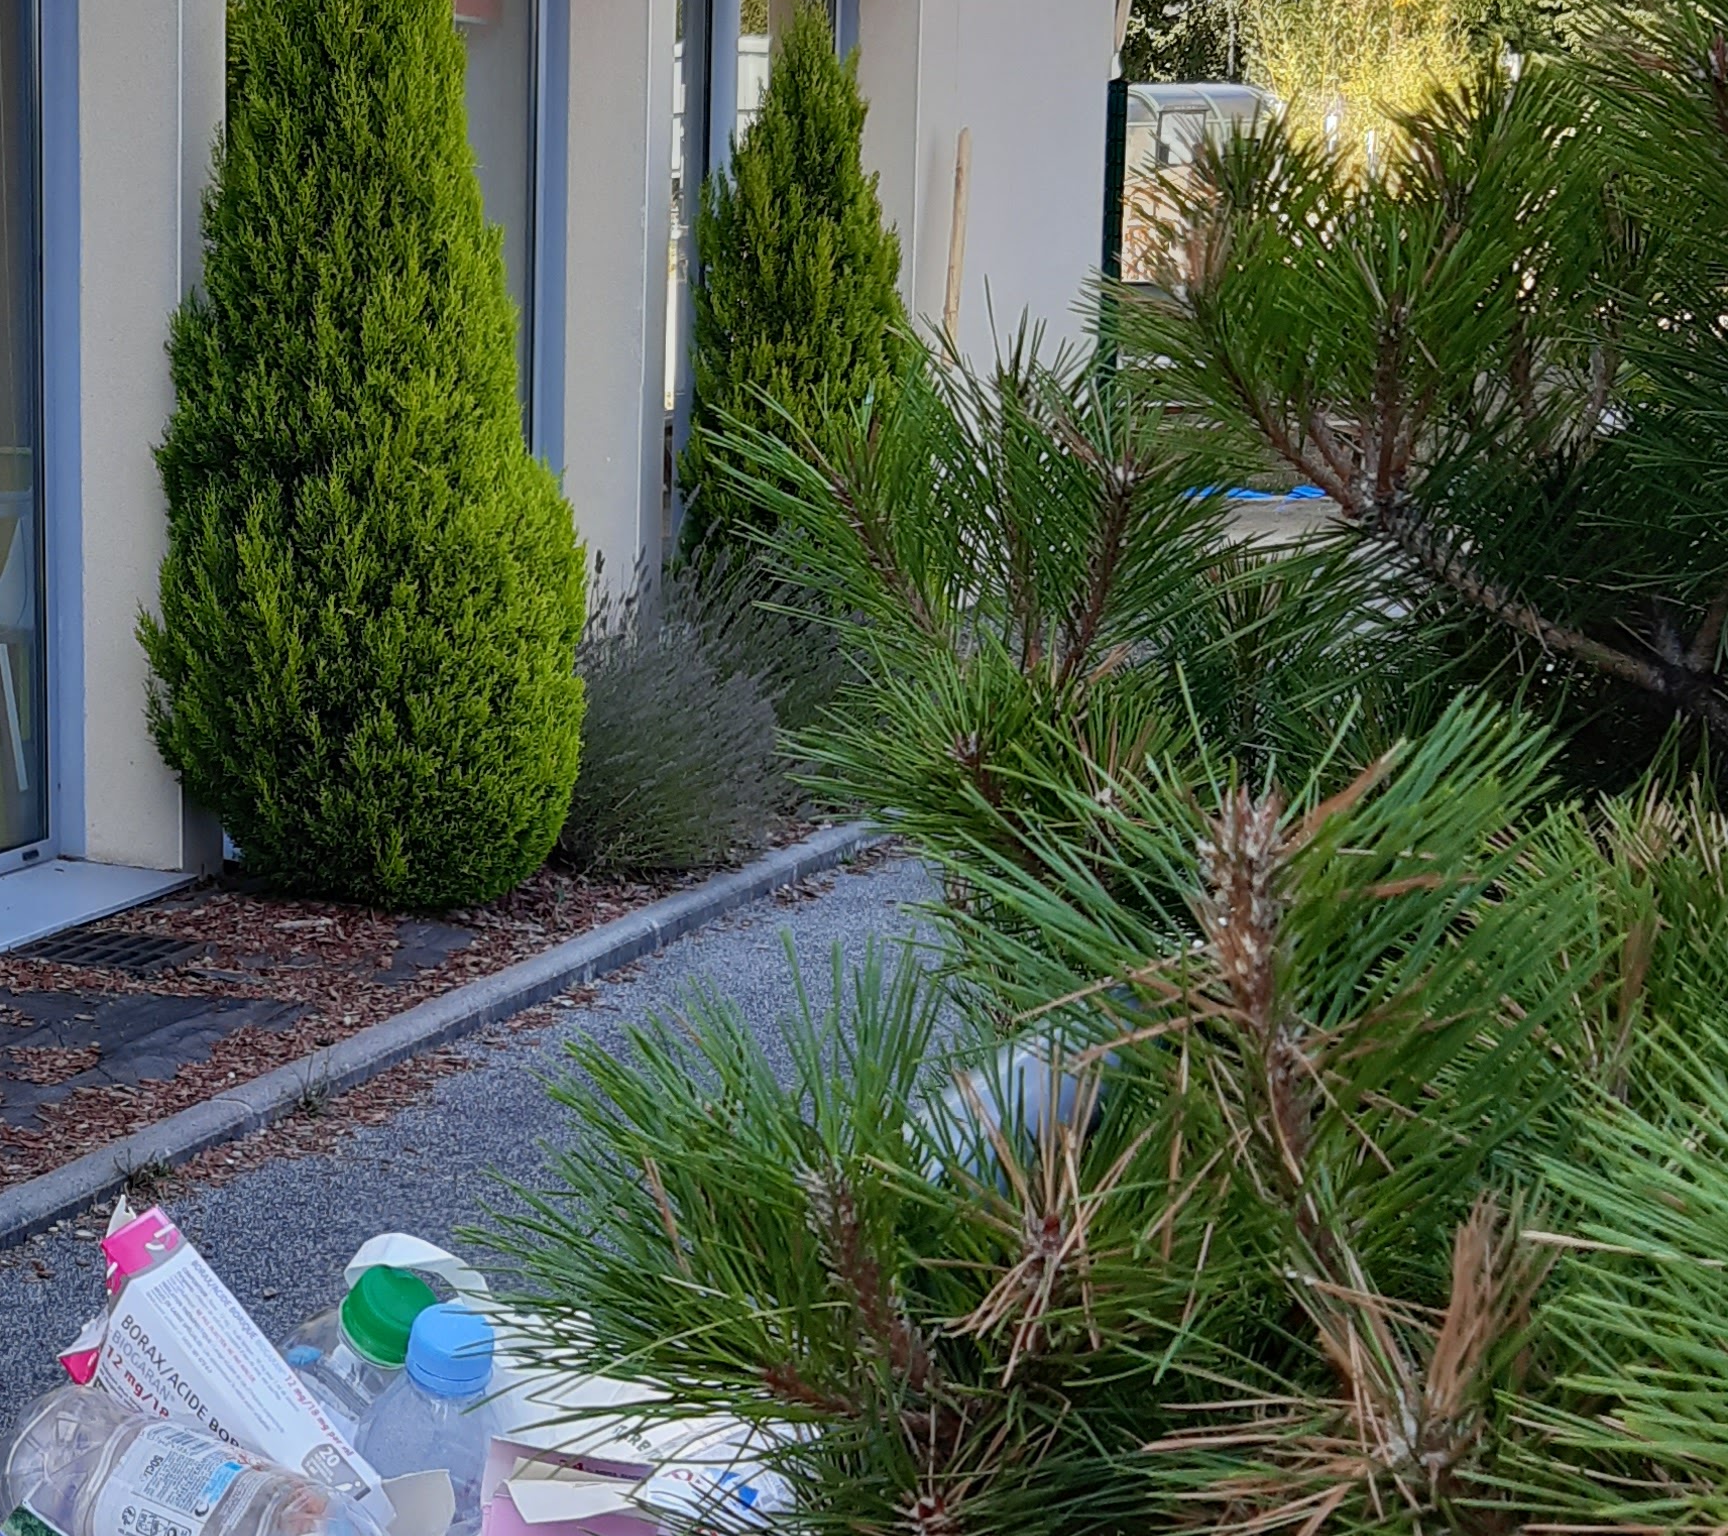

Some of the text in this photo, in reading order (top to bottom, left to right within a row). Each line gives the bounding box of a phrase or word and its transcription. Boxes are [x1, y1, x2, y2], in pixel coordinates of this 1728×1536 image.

[102, 1344, 125, 1369] 12
[118, 1314, 210, 1419] BORAX/ACIDE
[282, 1374, 296, 1389] 12
[317, 1443, 341, 1469] 20
